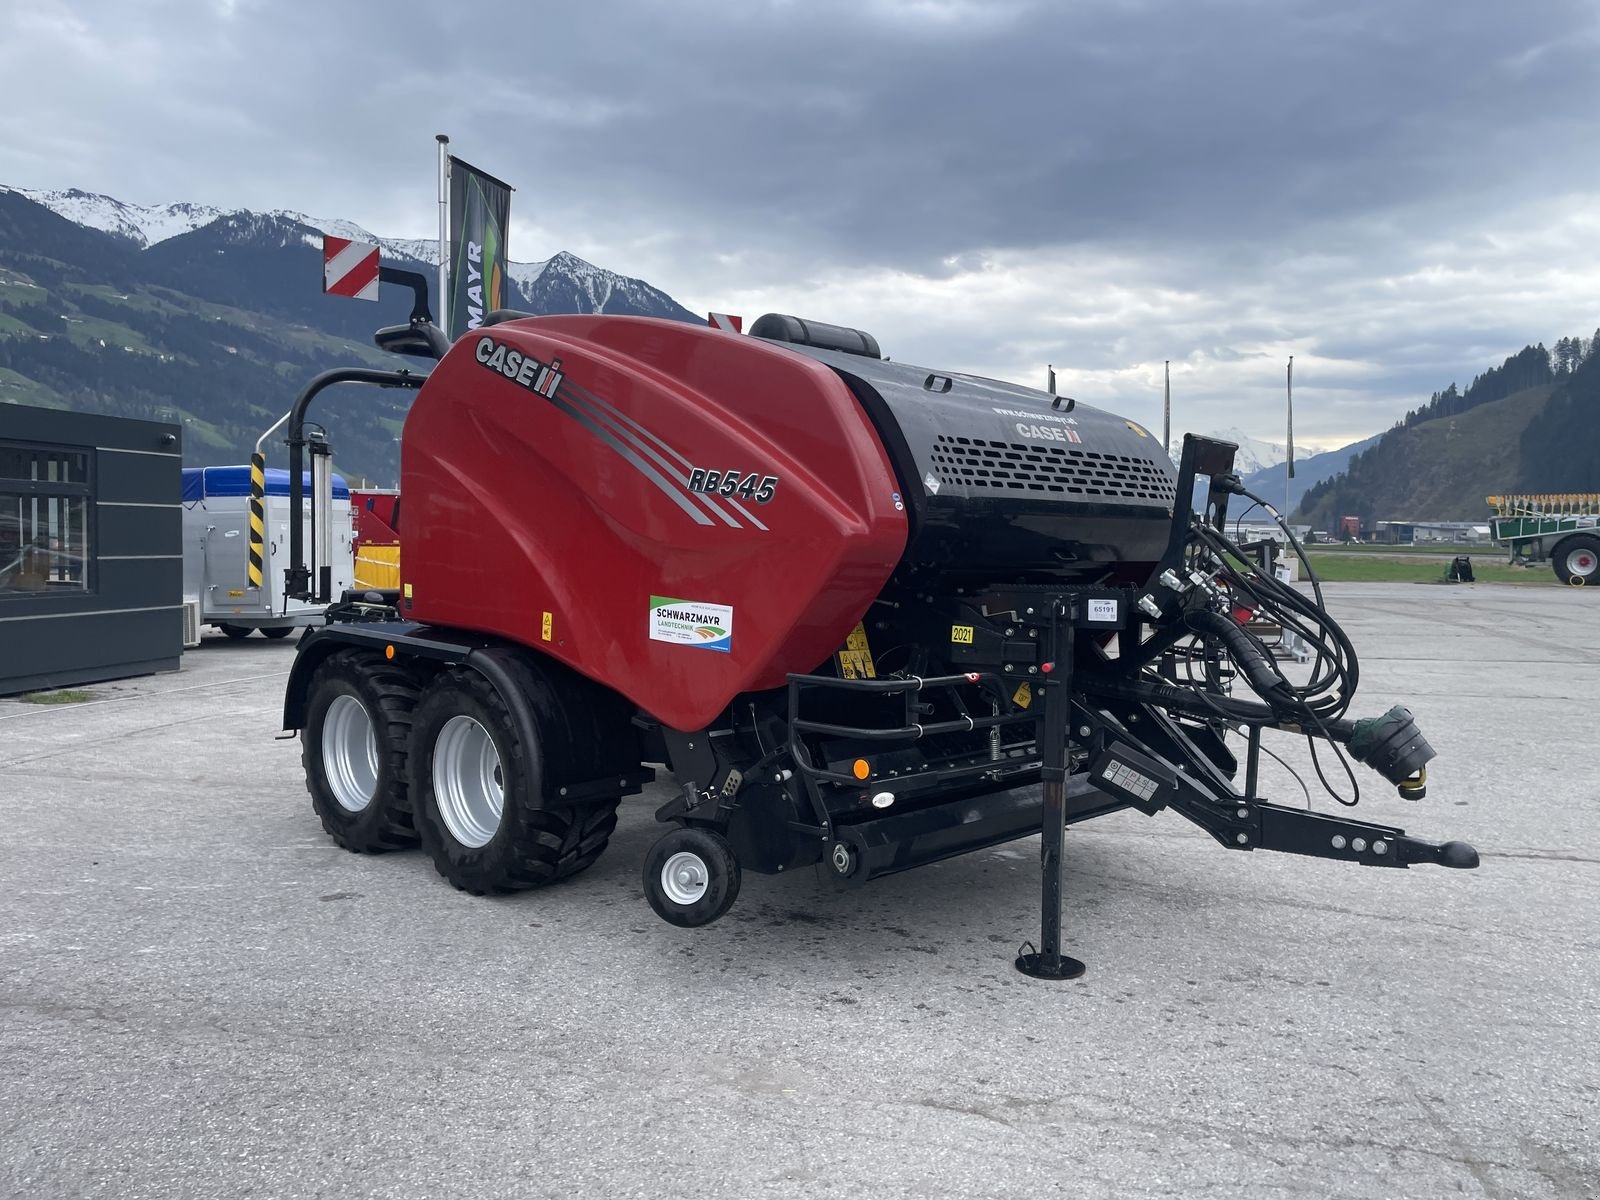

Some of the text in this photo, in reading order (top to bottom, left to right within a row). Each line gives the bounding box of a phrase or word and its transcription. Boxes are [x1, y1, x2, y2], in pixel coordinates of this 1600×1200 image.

[475, 336, 540, 387] CASE
[1015, 422, 1066, 443] CASE
[686, 466, 779, 504] RB545
[657, 608, 720, 625] SCHWARZMAYR
[657, 620, 694, 632] LANDTECHNIK
[953, 627, 972, 642] 2021
